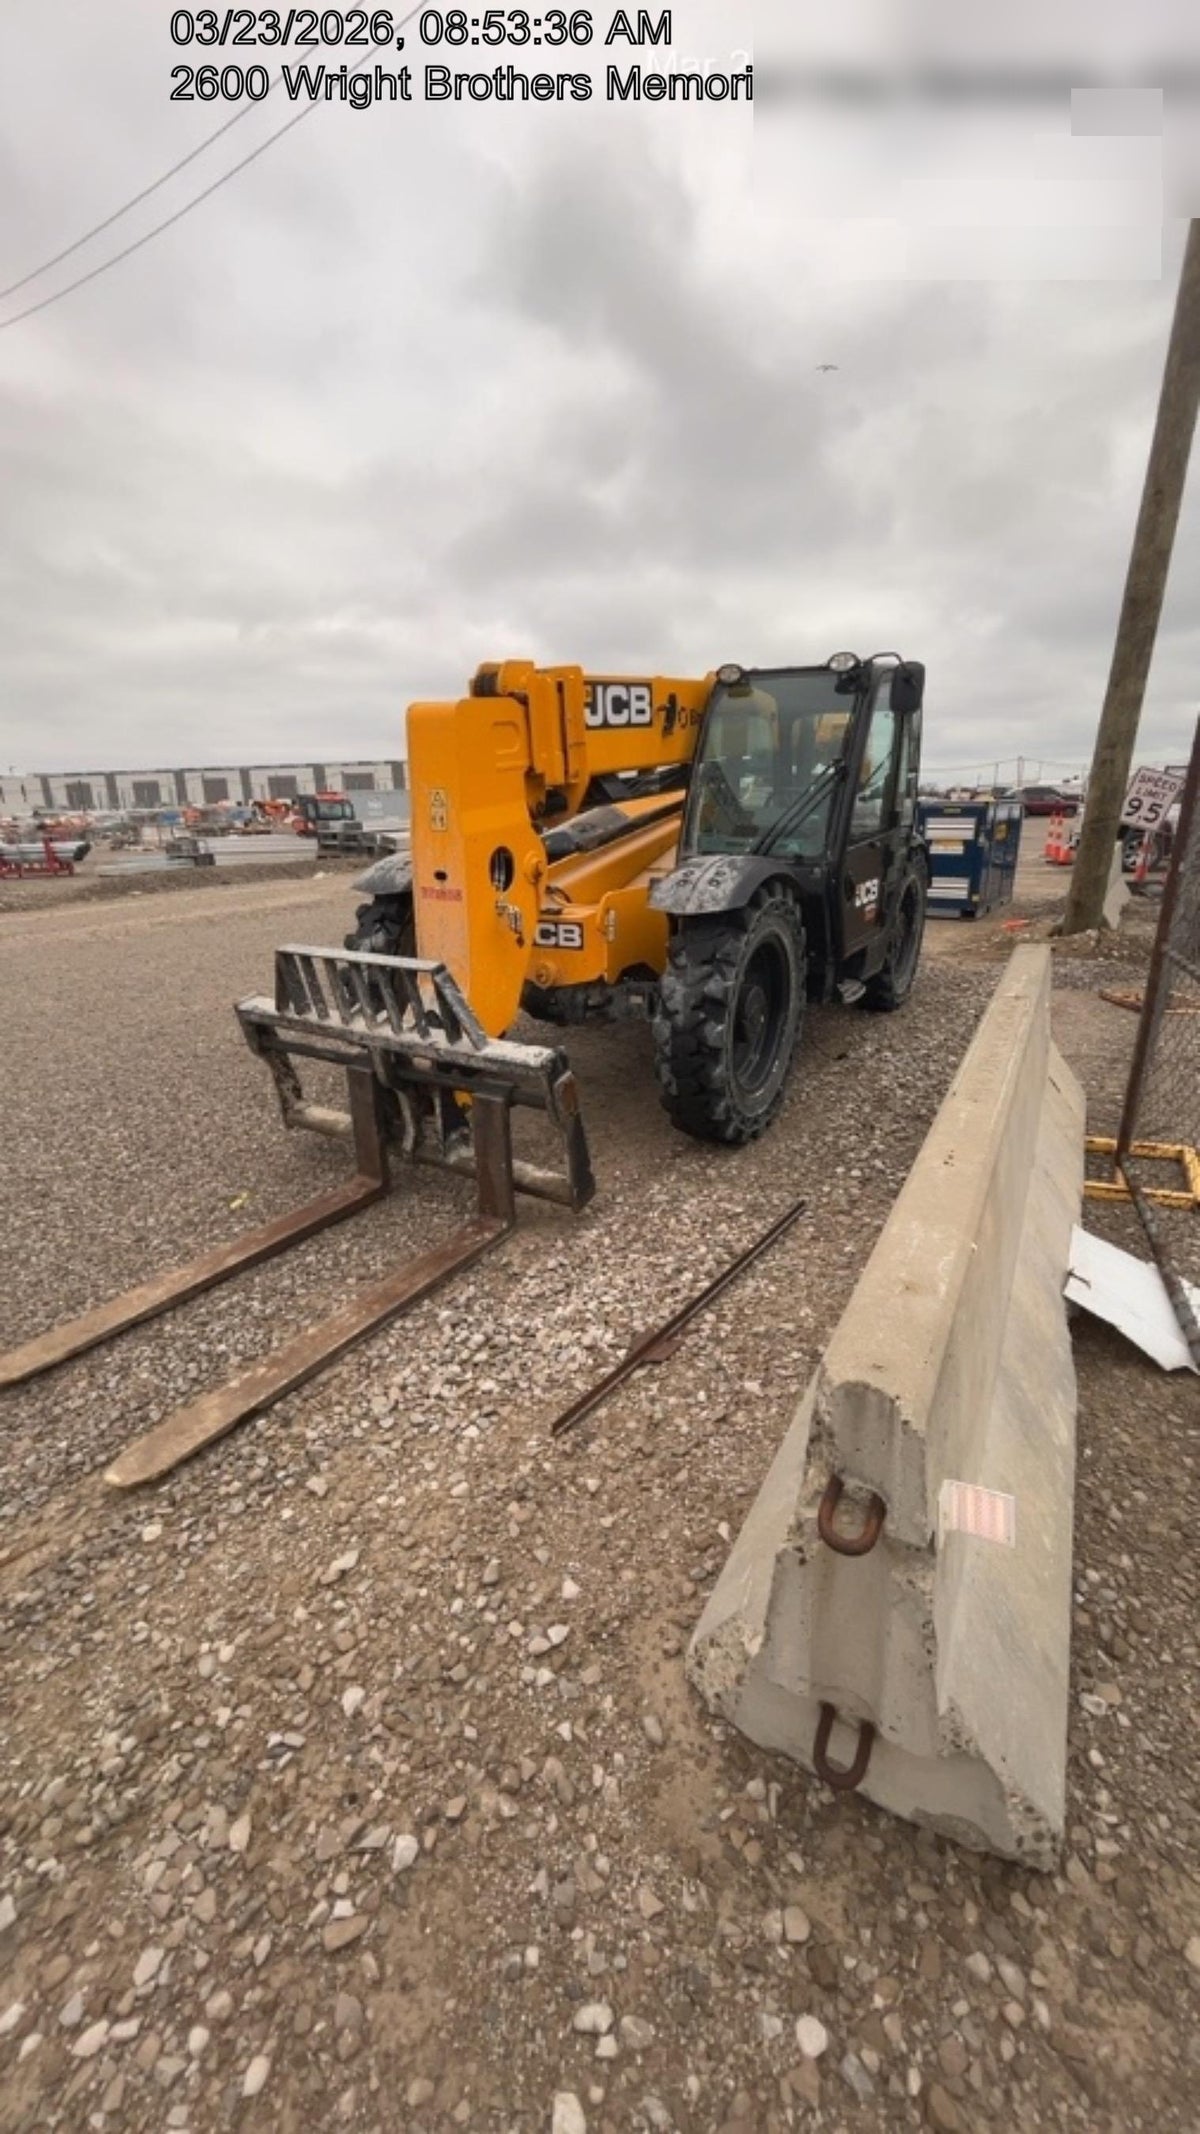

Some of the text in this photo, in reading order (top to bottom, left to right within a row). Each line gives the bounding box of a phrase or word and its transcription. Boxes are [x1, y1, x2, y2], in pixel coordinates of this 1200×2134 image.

[584, 684, 651, 727] JCB
[1139, 773, 1177, 793] SPEED
[855, 879, 878, 907] JCB
[535, 923, 582, 947] CB
